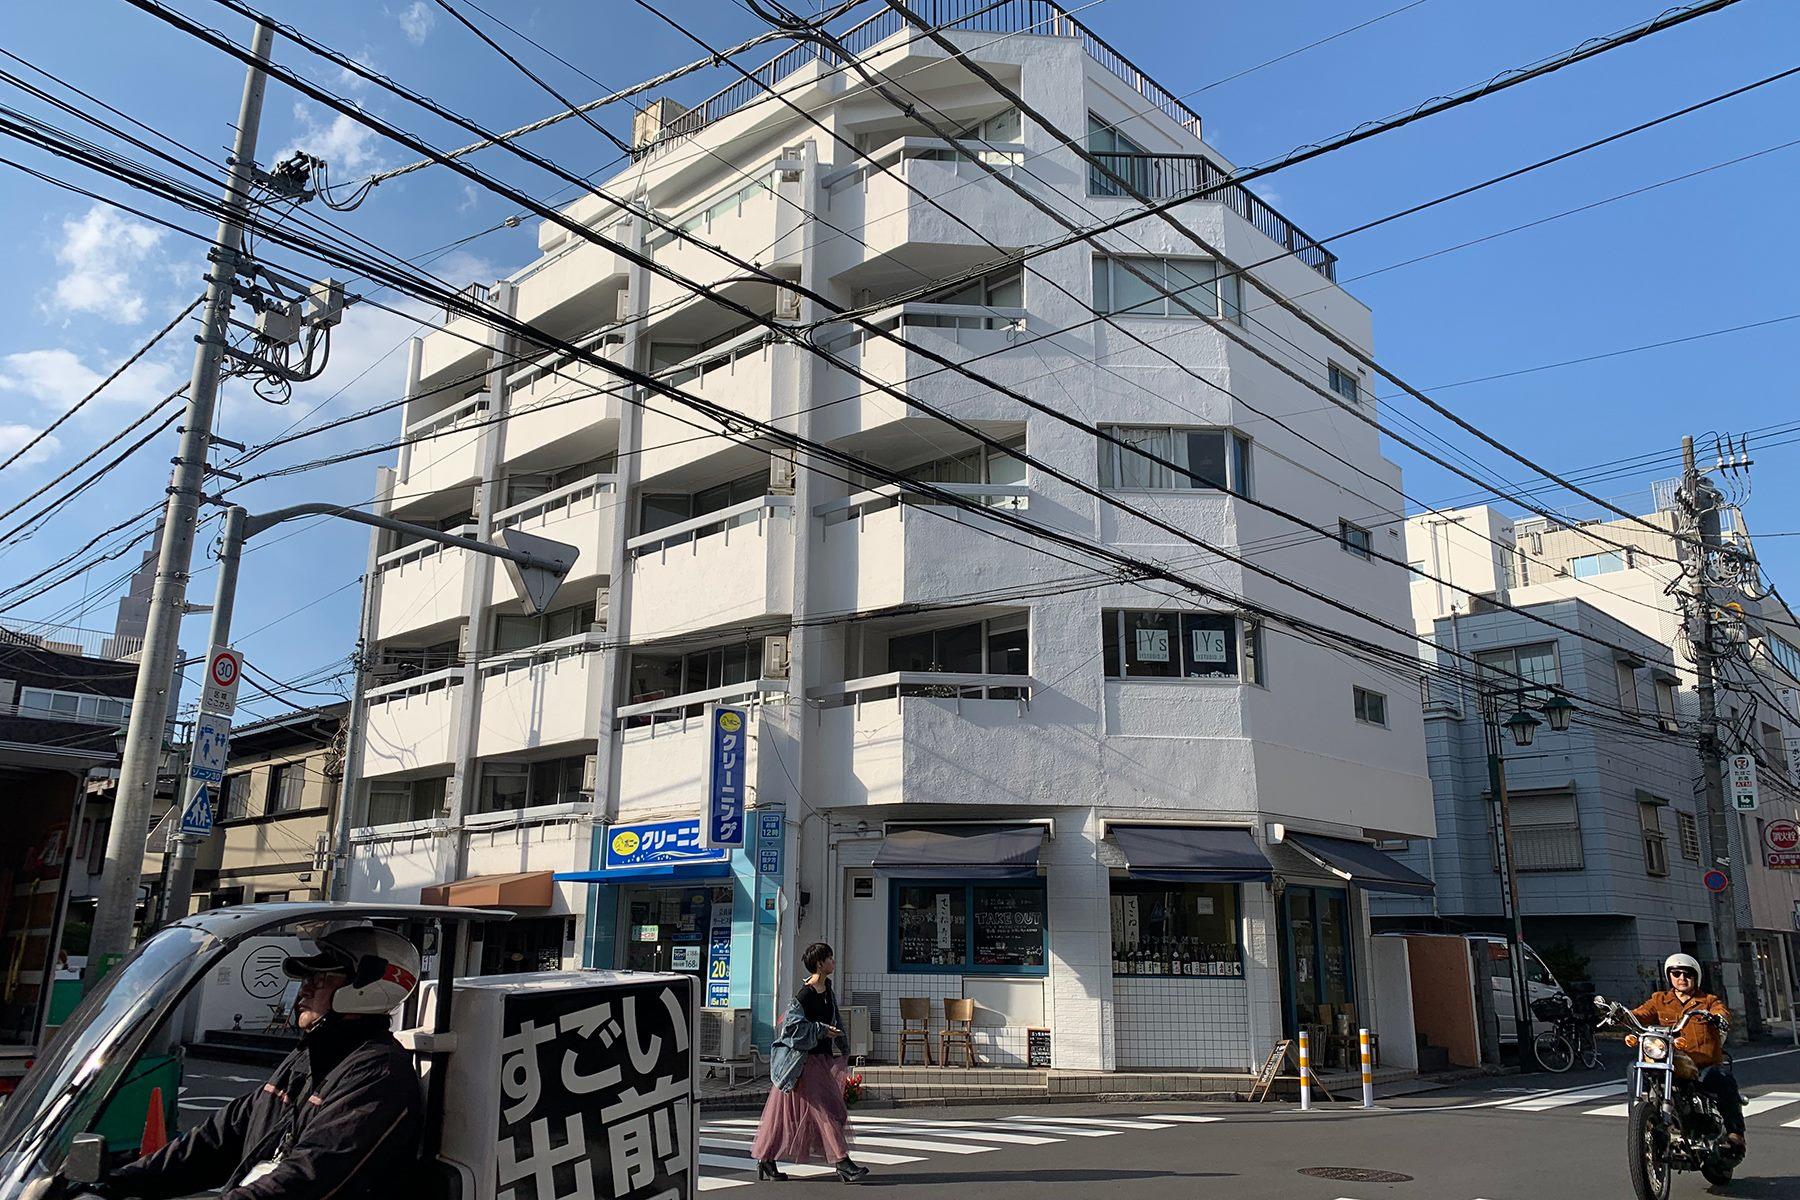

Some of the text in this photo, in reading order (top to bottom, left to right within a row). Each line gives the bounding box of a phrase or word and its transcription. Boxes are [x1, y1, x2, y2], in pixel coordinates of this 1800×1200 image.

[218, 662, 233, 678] 30
[206, 698, 231, 710] ここから
[720, 734, 738, 840] クリーニング
[1772, 831, 1798, 842] 消火栓
[975, 912, 1012, 925] TAKE
[1014, 912, 1041, 925] OUT
[711, 960, 726, 978] 20
[500, 987, 689, 1125] すごい
[497, 1075, 689, 1200] 出前
